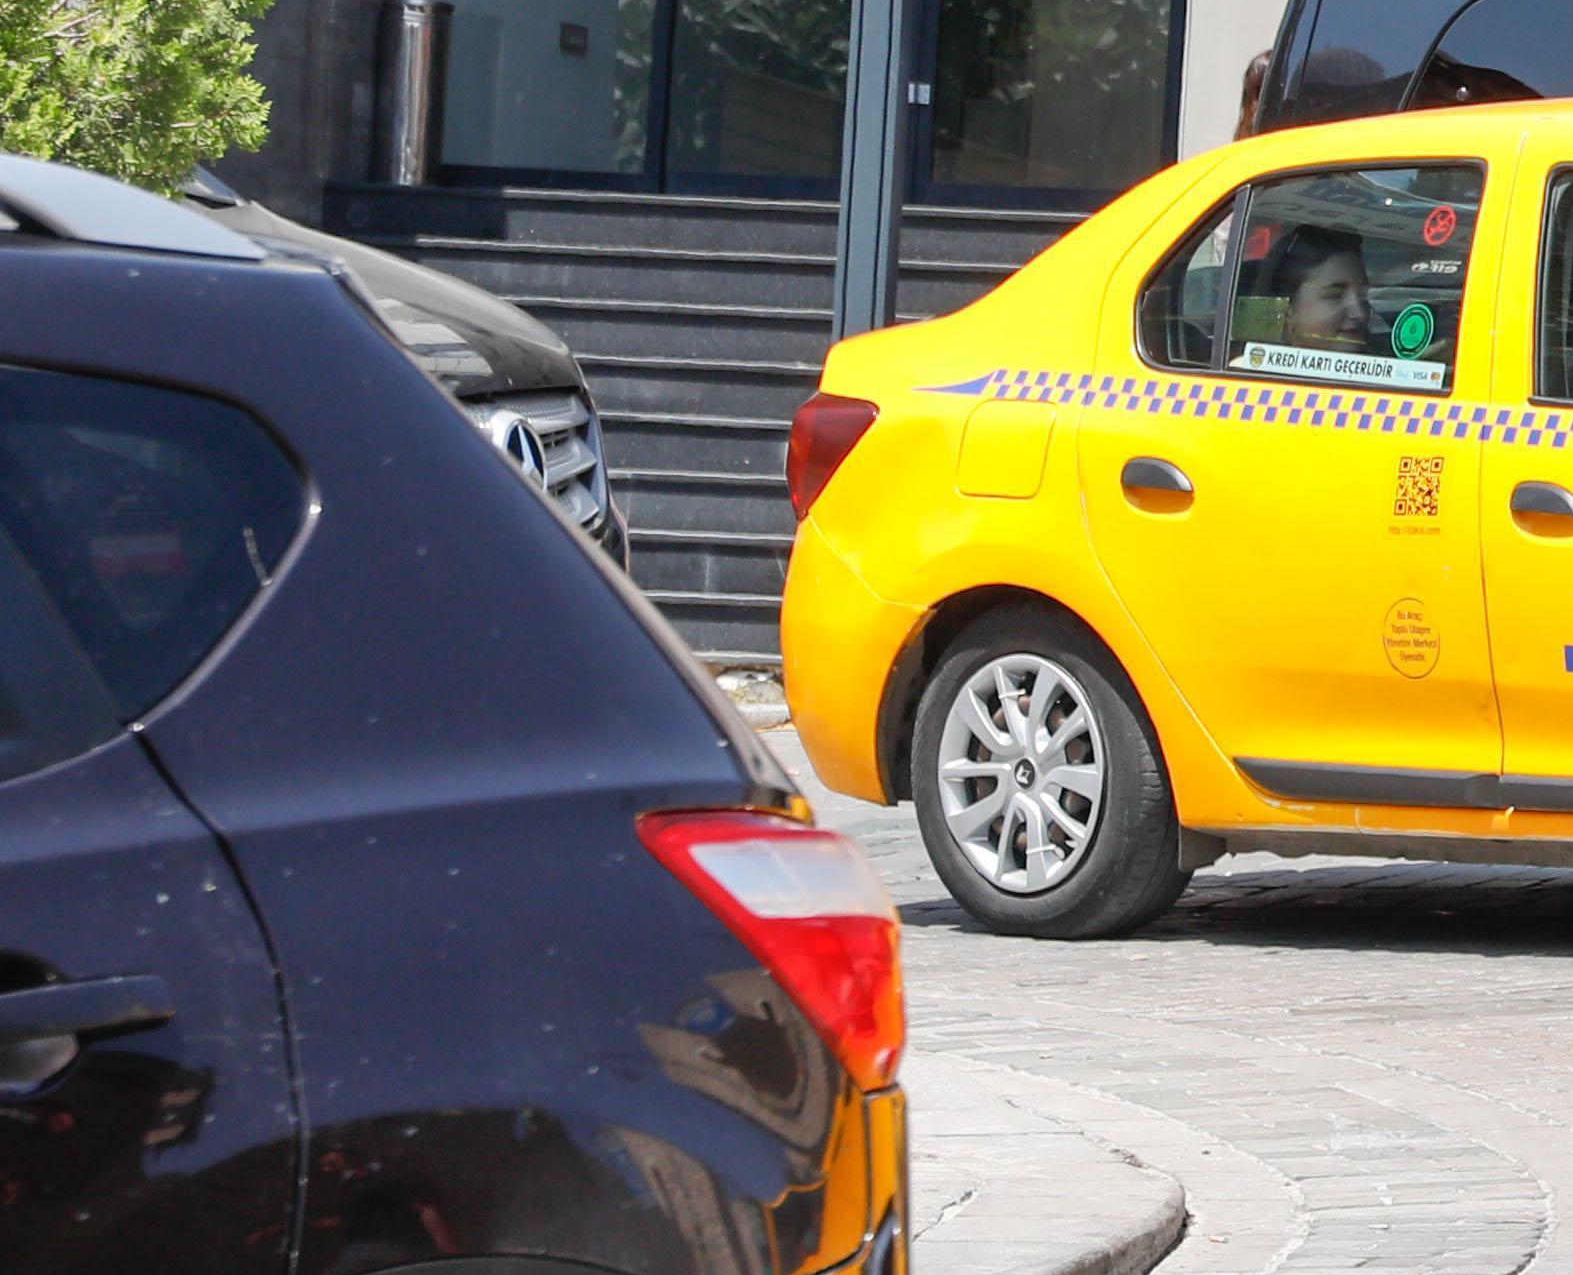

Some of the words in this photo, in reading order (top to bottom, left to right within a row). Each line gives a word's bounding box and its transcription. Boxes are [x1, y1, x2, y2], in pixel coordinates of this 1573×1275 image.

[1266, 351, 1300, 368] KREDİ
[1301, 355, 1332, 372] KARTI
[1335, 359, 1393, 379] GEÇERLİDİR
